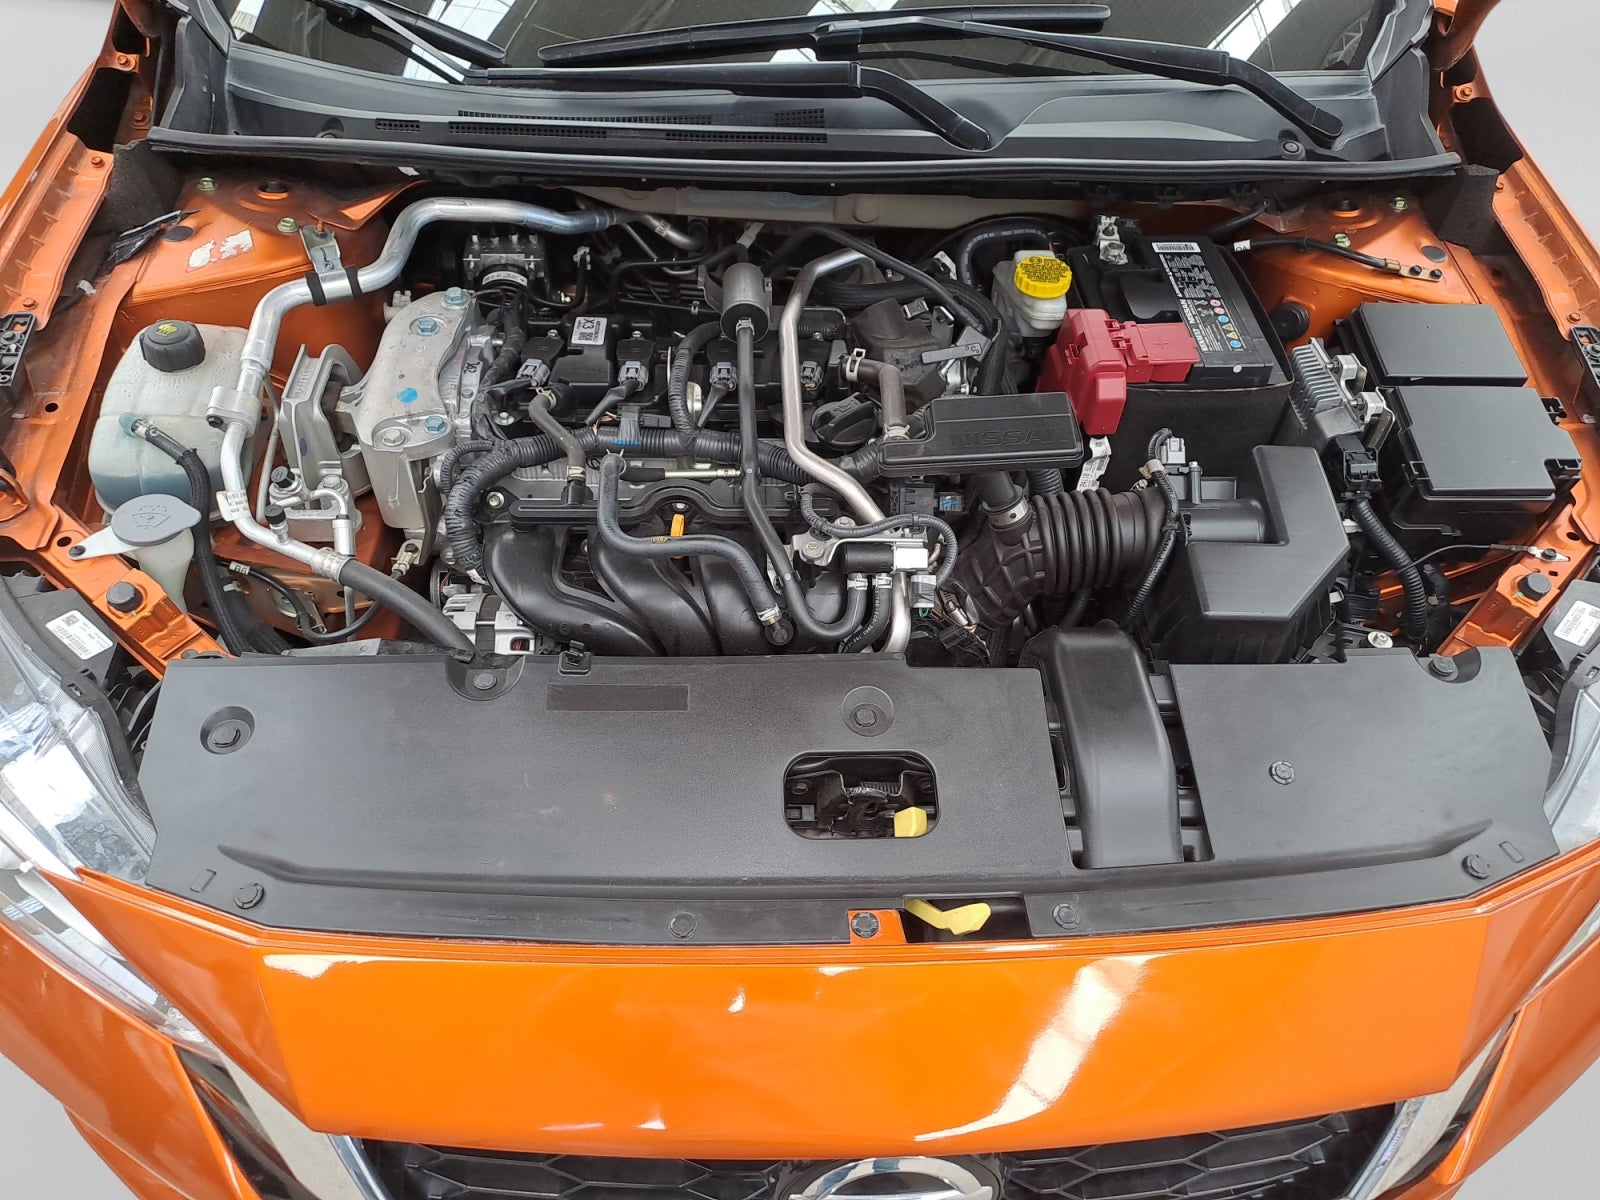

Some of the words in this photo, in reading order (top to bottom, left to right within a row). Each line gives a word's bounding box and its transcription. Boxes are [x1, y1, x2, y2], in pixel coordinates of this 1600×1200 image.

[1179, 299, 1196, 324] NISSAN
[582, 318, 596, 330] X3
[951, 424, 1069, 448] NISSAN
